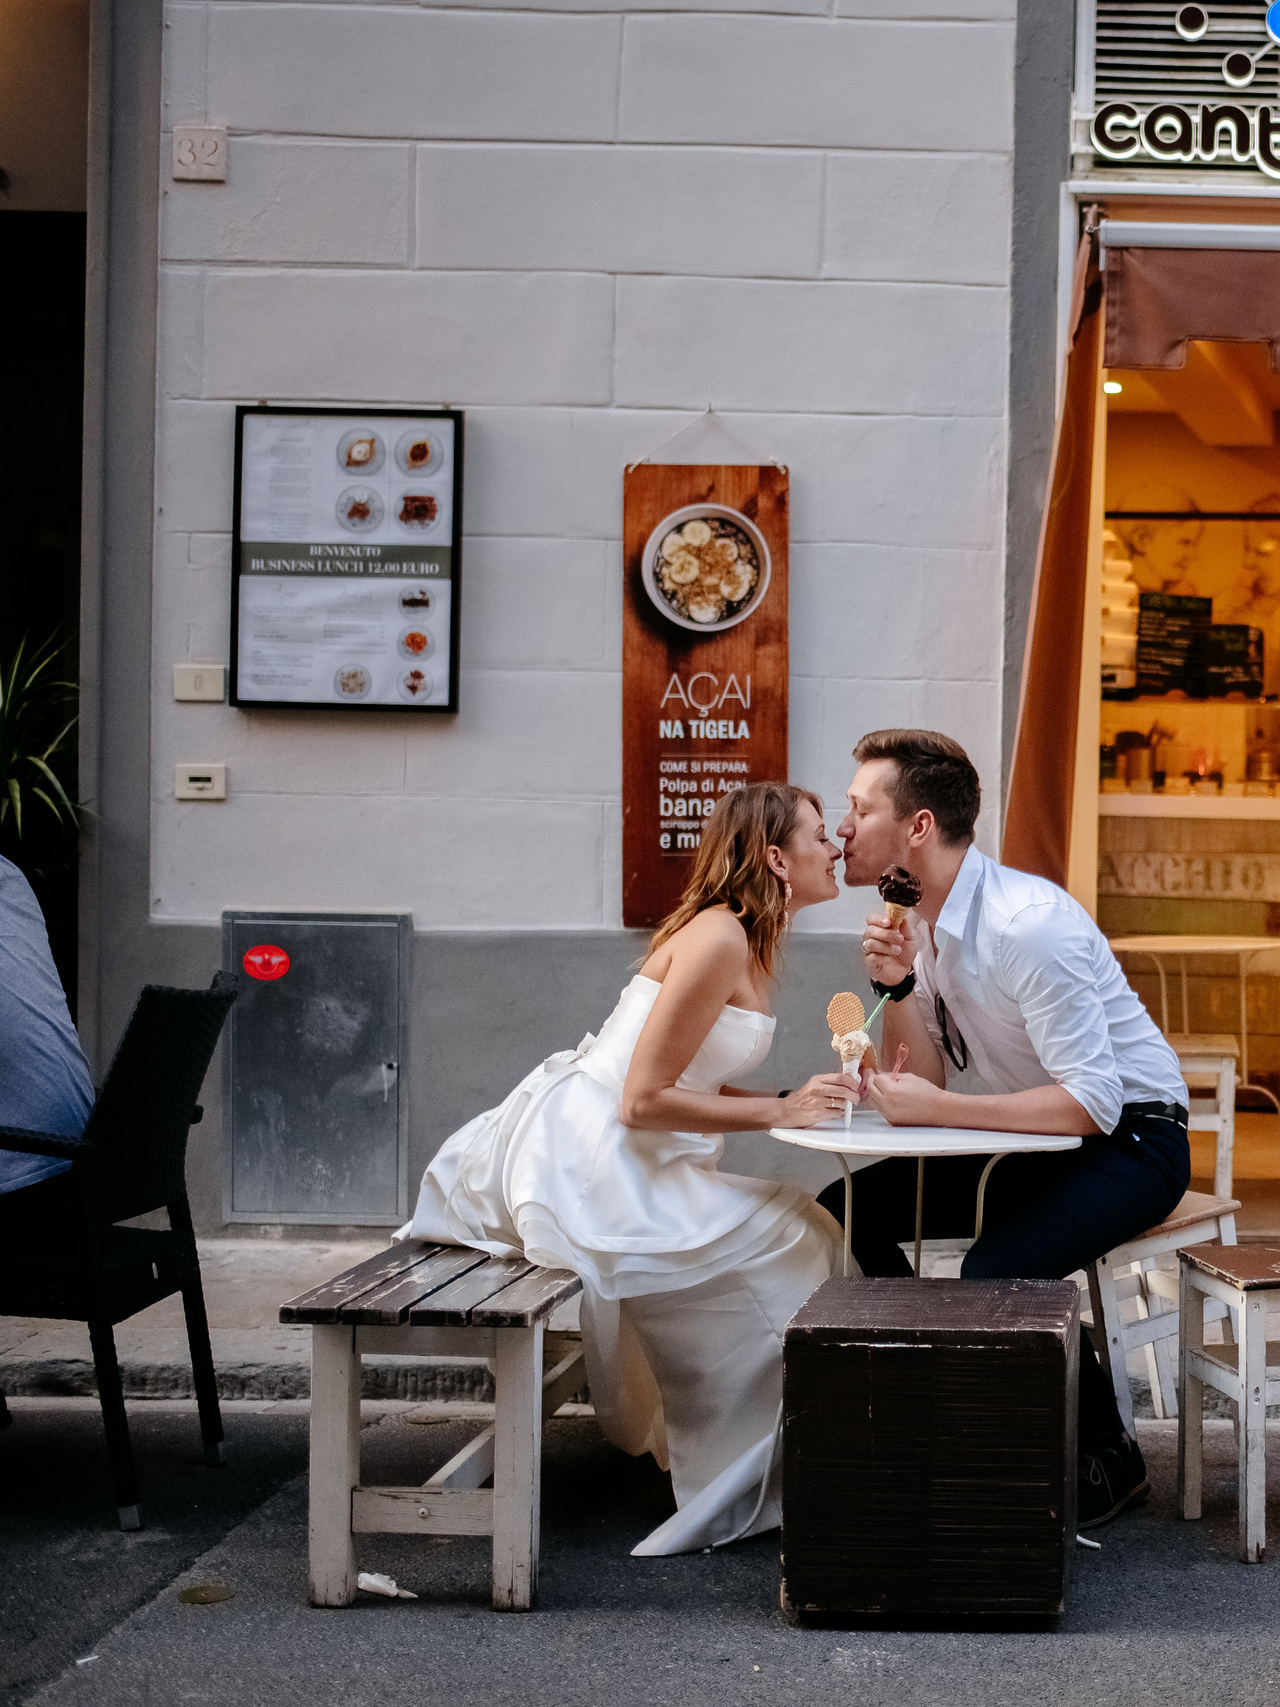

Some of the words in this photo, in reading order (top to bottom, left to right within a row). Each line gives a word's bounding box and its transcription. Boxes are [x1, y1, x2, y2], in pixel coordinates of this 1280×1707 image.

[178, 139, 219, 167] 32
[309, 544, 382, 558] BENVENUTO
[250, 558, 315, 572] BUSINESS
[317, 559, 364, 574] LUNCH
[401, 562, 440, 575] EURO
[660, 671, 751, 718] AÇAI
[659, 719, 685, 739] NA
[688, 719, 751, 739] TIGELA
[660, 761, 688, 774] COME
[690, 761, 701, 774] SI
[659, 777, 698, 796] Polpa
[701, 778, 715, 793] di
[659, 793, 716, 817] bana
[659, 832, 672, 850] e
